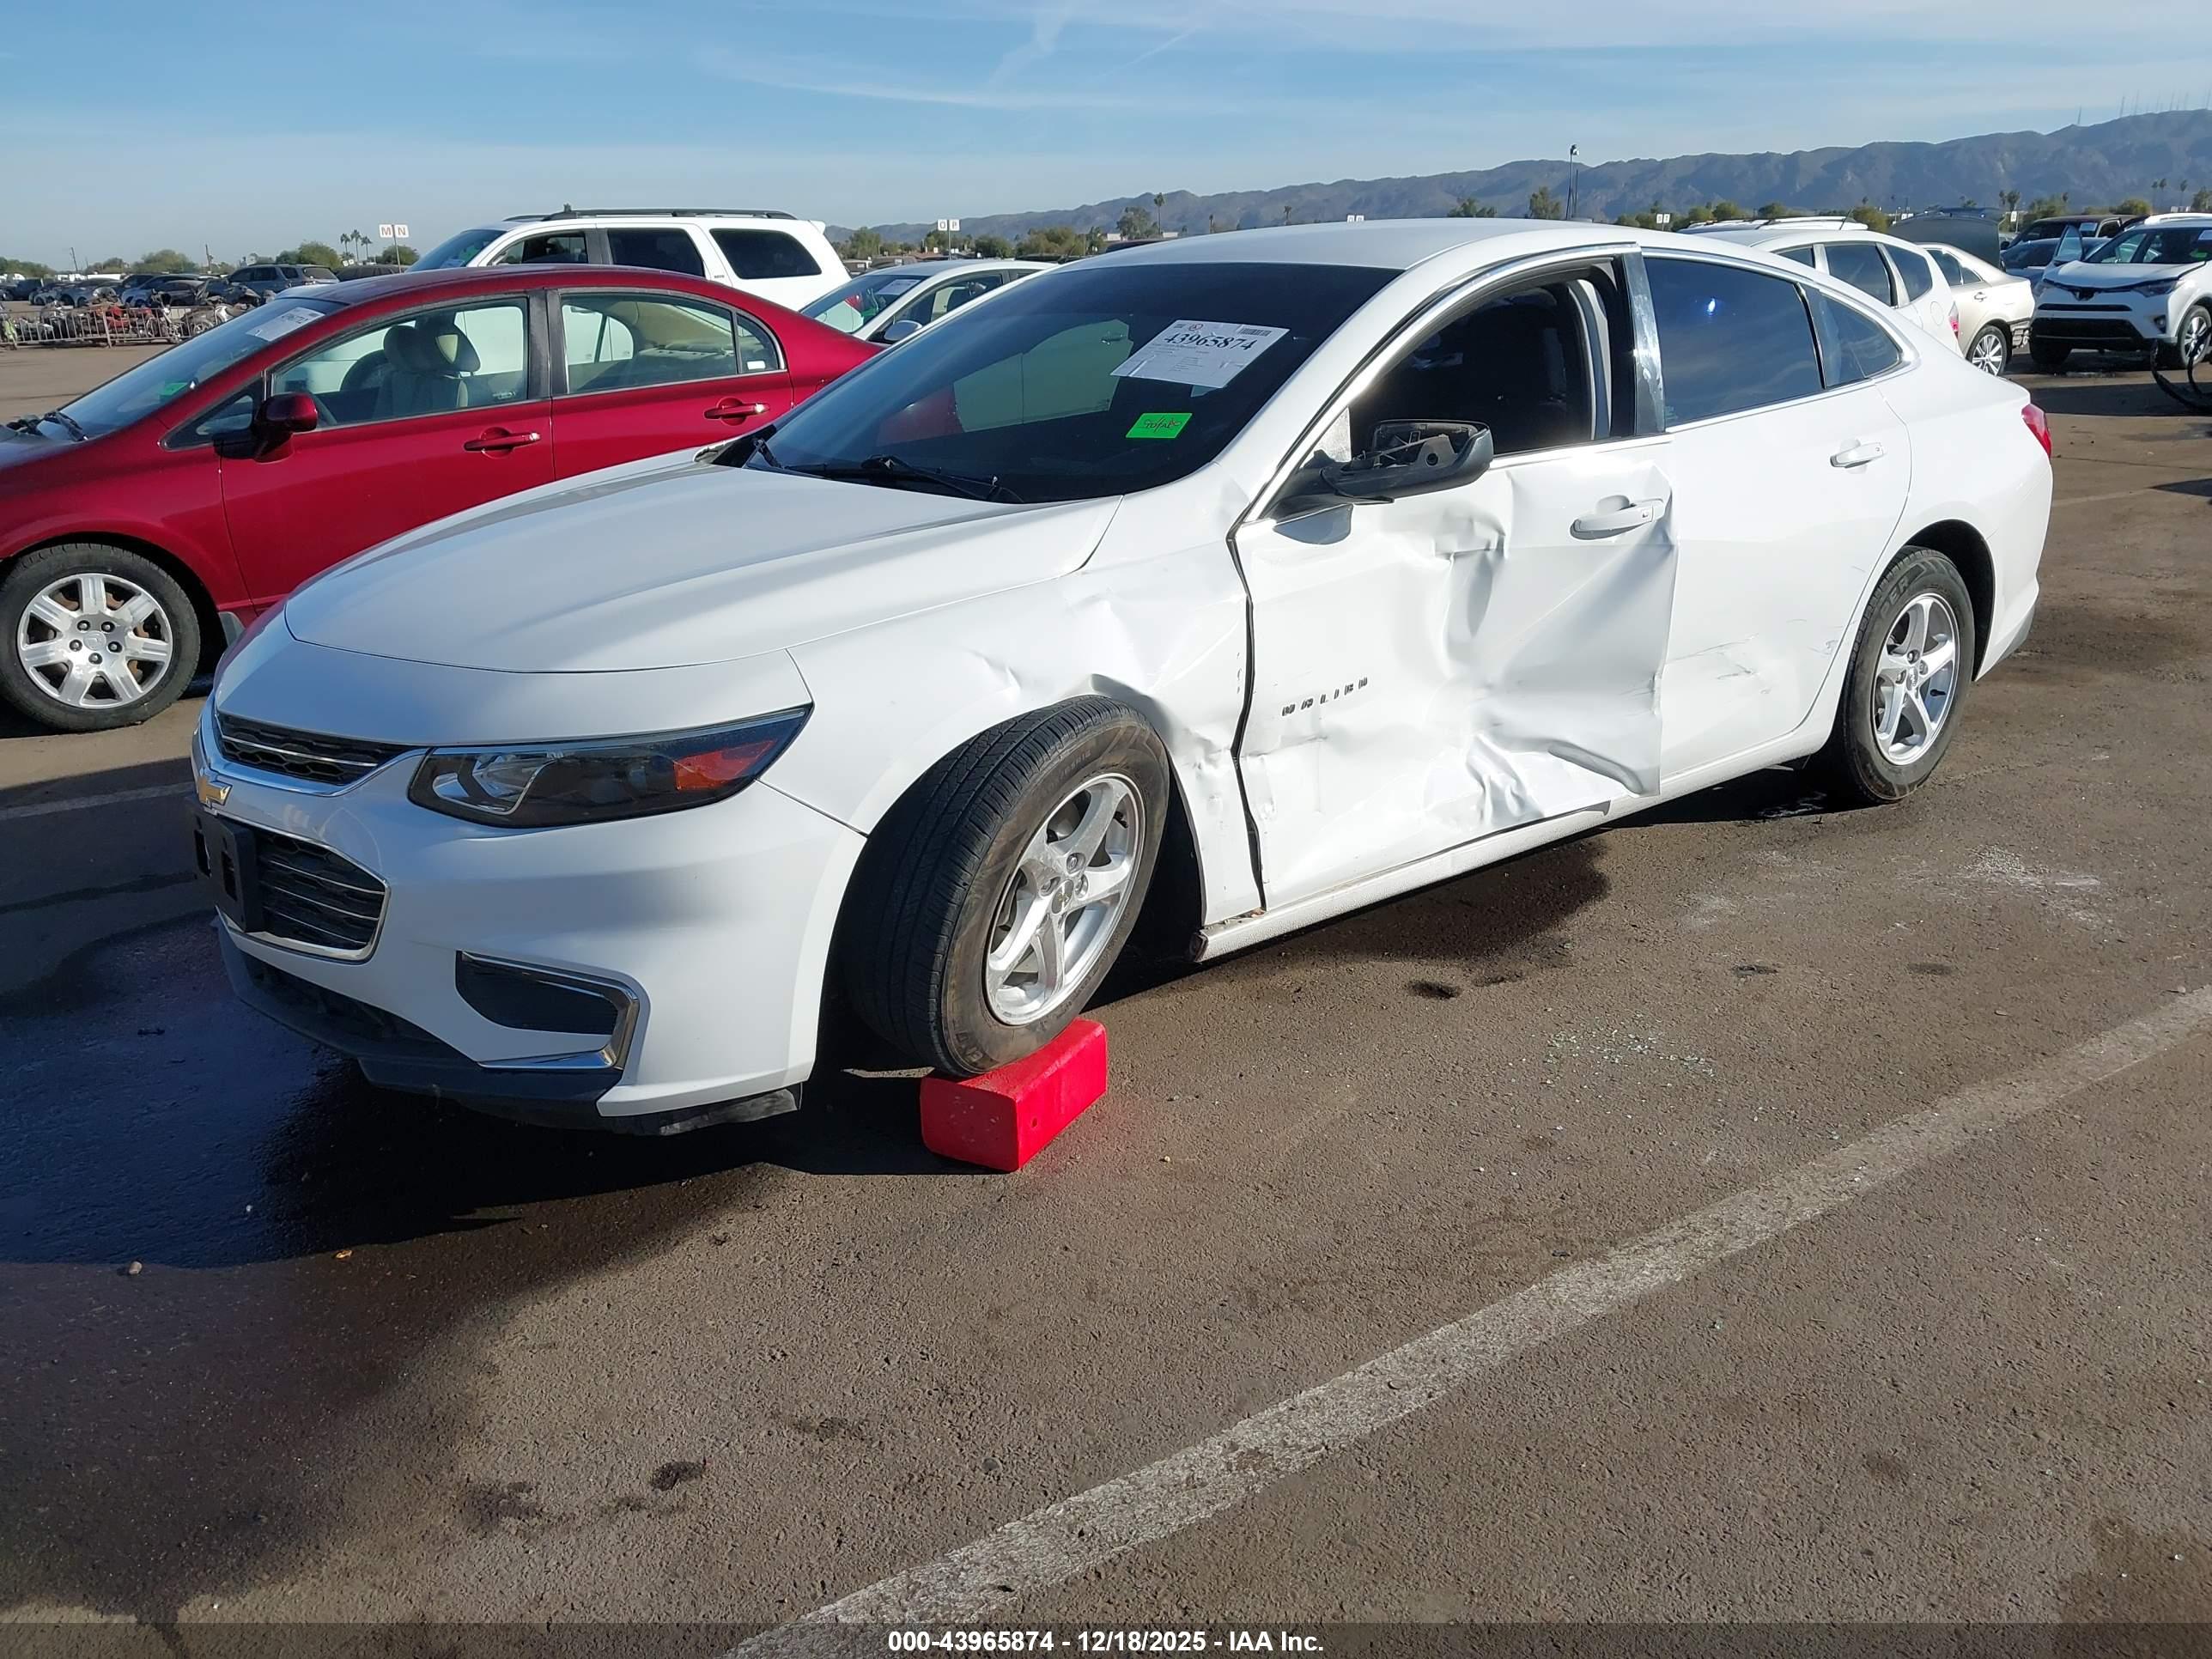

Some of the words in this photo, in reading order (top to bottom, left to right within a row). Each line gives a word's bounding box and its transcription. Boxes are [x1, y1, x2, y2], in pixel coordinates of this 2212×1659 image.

[380, 226, 392, 235] M
[398, 227, 406, 235] N
[1164, 331, 1258, 350] 43965874
[1281, 677, 1368, 717] MALIBU
